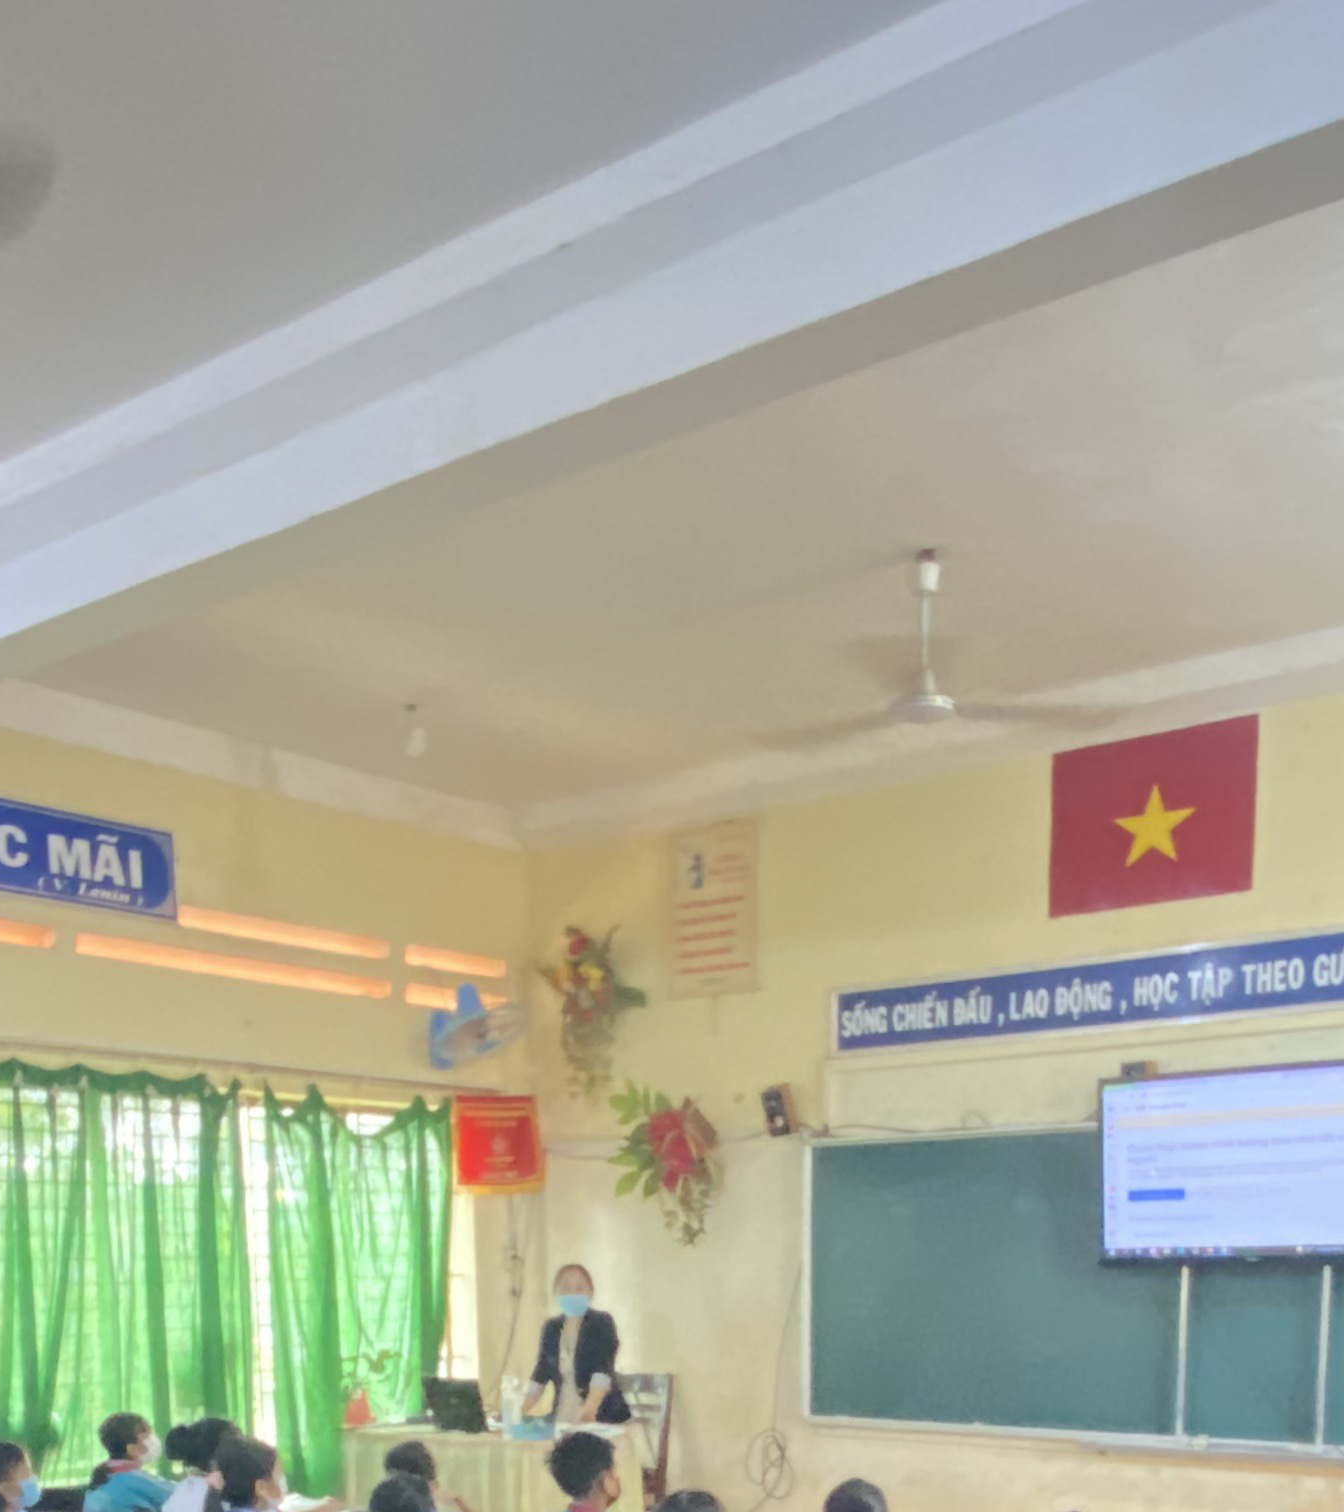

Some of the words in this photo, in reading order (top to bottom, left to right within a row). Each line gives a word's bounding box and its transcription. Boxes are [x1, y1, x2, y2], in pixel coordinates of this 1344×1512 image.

[46, 832, 144, 890] MÃI
[840, 1000, 889, 1038] SỐNG
[891, 991, 949, 1032] CHIẾN
[953, 985, 993, 1026] ĐẤU
[1008, 987, 1050, 1021] LAO
[1054, 977, 1113, 1021] ĐỘNG
[1133, 970, 1180, 1011] HỌC
[1187, 960, 1234, 1005] TẬP
[1241, 956, 1305, 996] THEO
